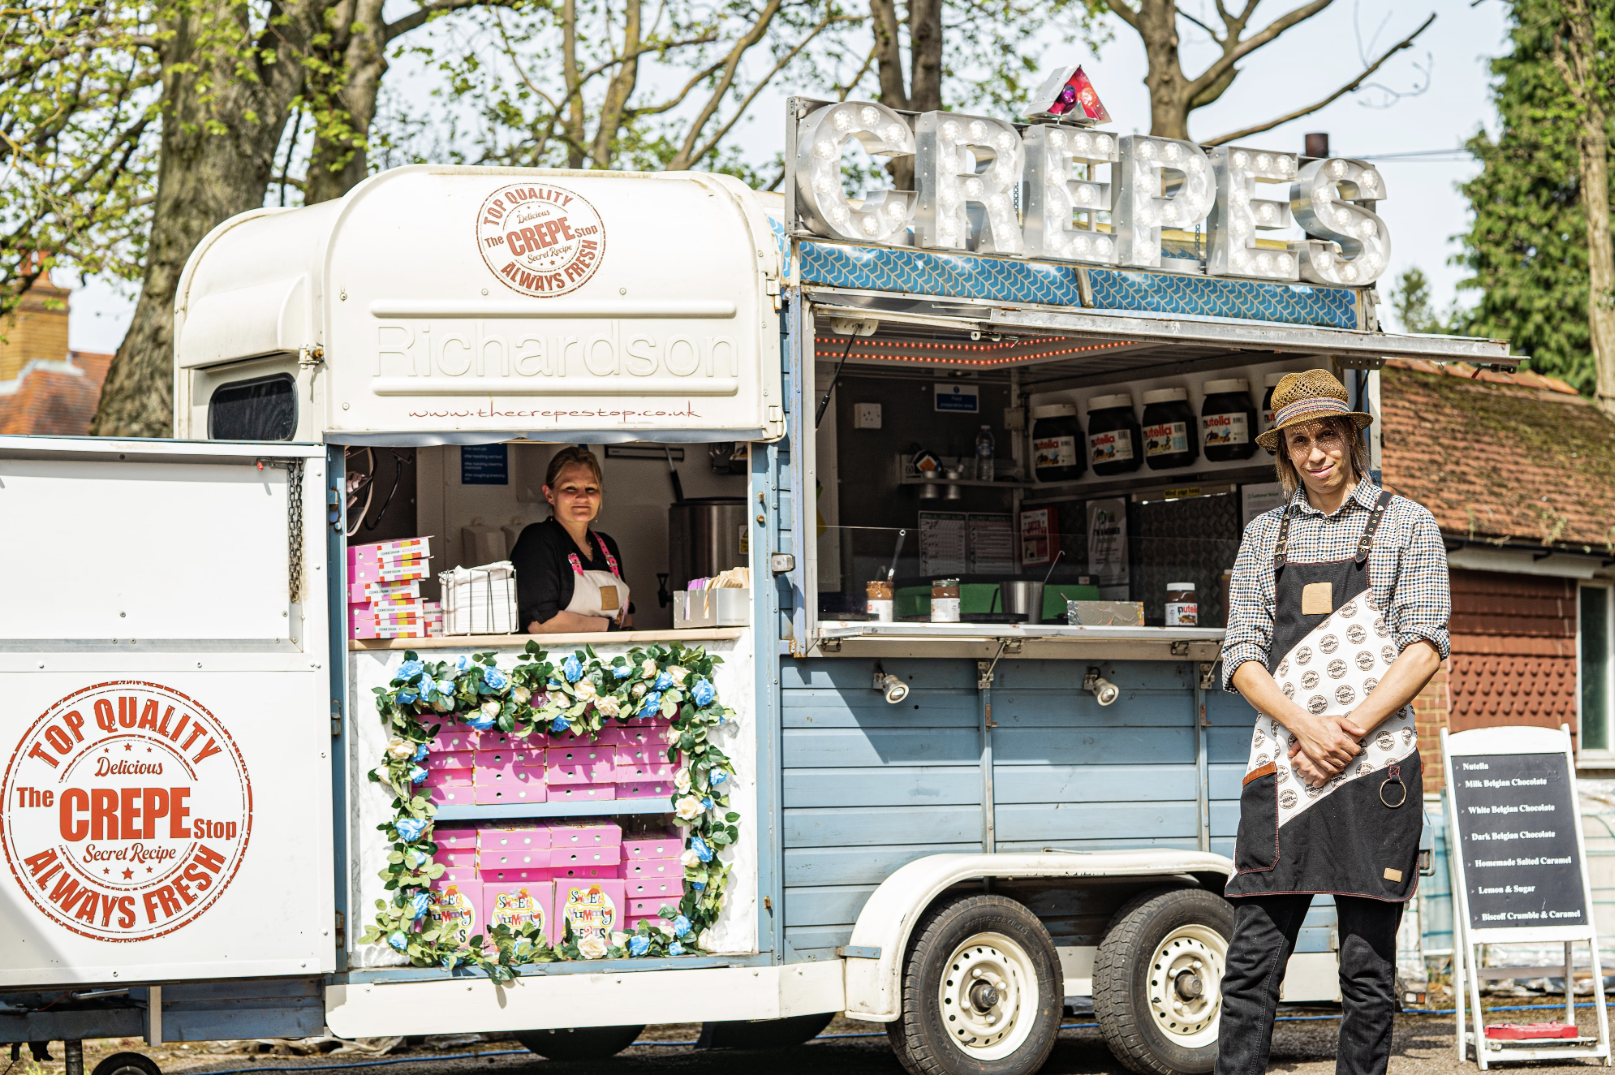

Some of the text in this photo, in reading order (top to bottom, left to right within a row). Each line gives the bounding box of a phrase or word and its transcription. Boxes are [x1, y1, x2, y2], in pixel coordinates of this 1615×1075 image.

[484, 188, 573, 226] TOP QUALITY
[517, 210, 550, 224] Delicious
[484, 217, 598, 256] The CREPE Stop
[527, 244, 572, 264] Secret Recipe
[501, 240, 597, 291] ALWAYS FRESH
[371, 320, 739, 377] Richardson
[408, 400, 702, 423] www.thecrepestop.co.uk
[28, 696, 222, 770] TOP QUALITY
[94, 757, 163, 777] Delicious
[1462, 762, 1489, 771] Nutella
[1465, 777, 1547, 789] Milk Belgian Chocolate
[16, 787, 237, 841] The CREPE Stop
[1468, 803, 1555, 815] White Belgian Chocolate
[1471, 830, 1556, 841] Dark Belgian Chocolate
[83, 843, 176, 863] Secret Recipe
[1475, 856, 1572, 867] Homemade Salted Caramel
[24, 844, 227, 929] ALWAYS FRESH
[1478, 885, 1535, 894] Lemon & Sugar
[1481, 912, 1506, 921] Biscoff
[1507, 911, 1539, 920] Crumble
[1549, 909, 1581, 918] Caramel
